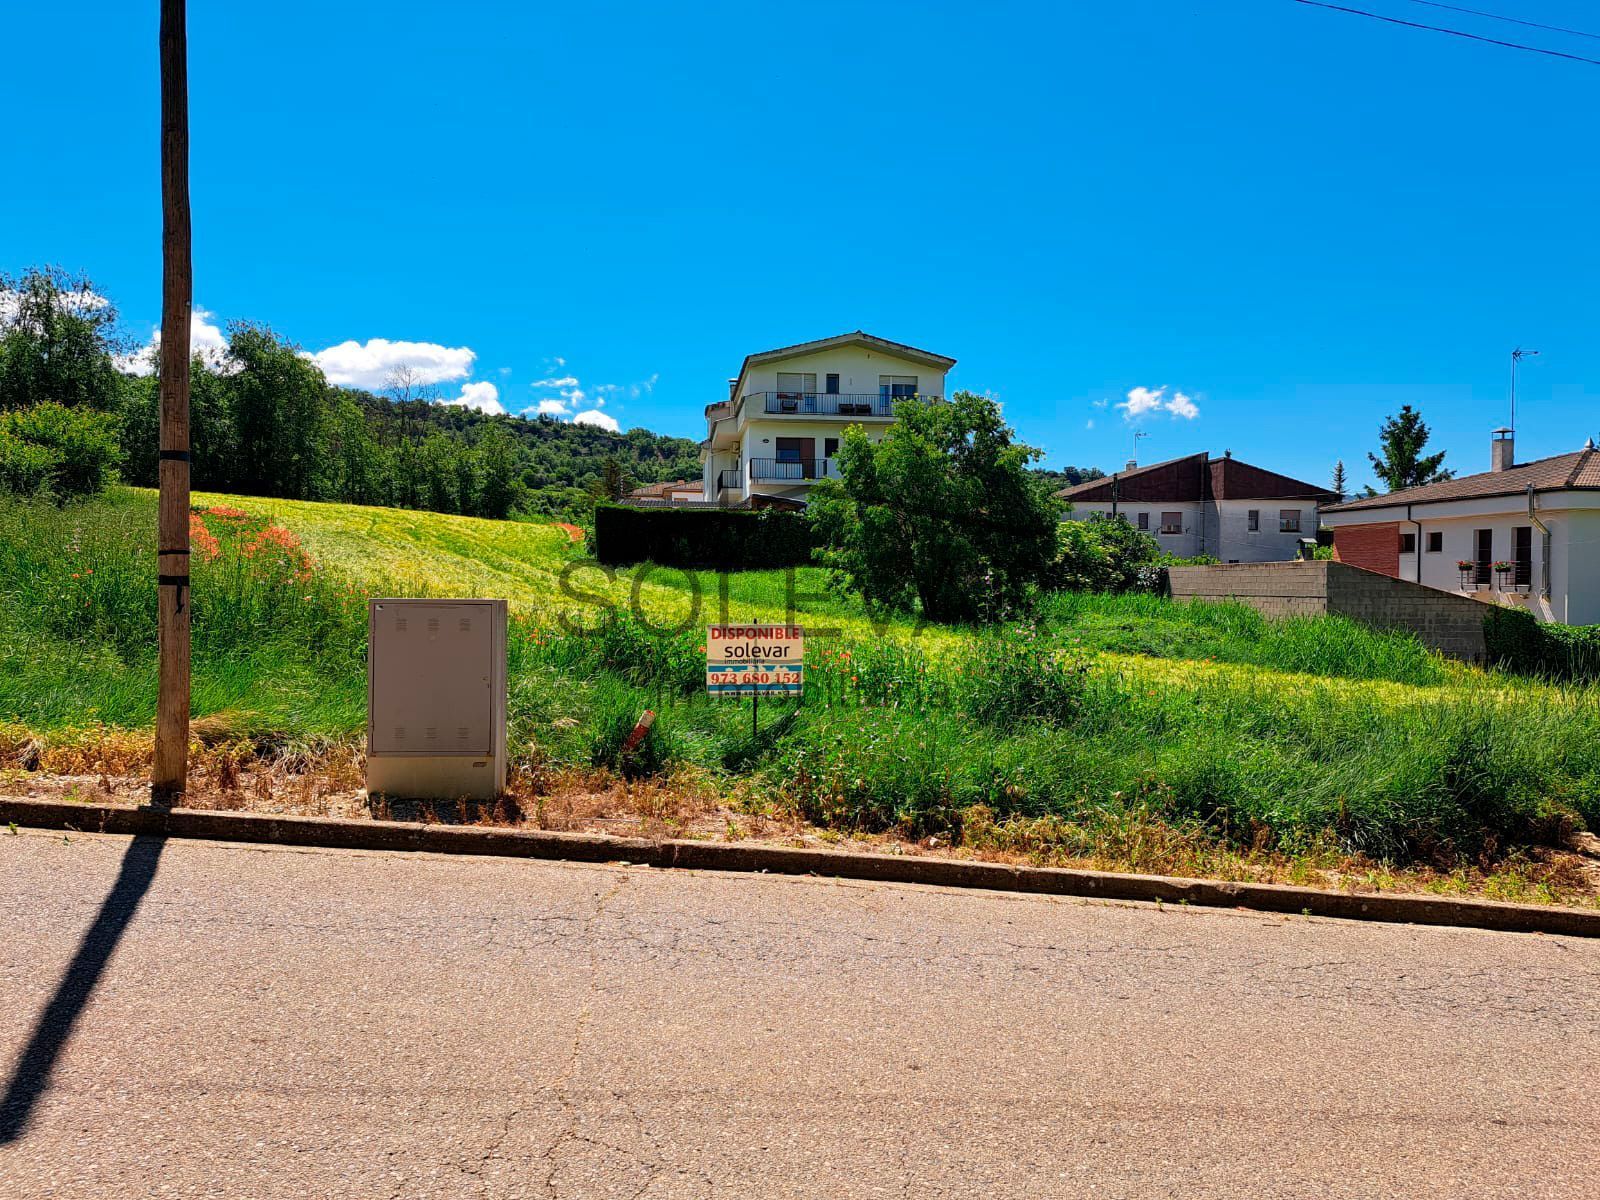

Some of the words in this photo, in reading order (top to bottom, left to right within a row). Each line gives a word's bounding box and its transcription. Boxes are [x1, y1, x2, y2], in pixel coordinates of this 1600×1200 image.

[711, 627, 799, 640] DISPONIBLE
[724, 642, 790, 658] solevar
[711, 672, 738, 685] 973
[742, 672, 770, 684] 680
[775, 672, 800, 684] 152
